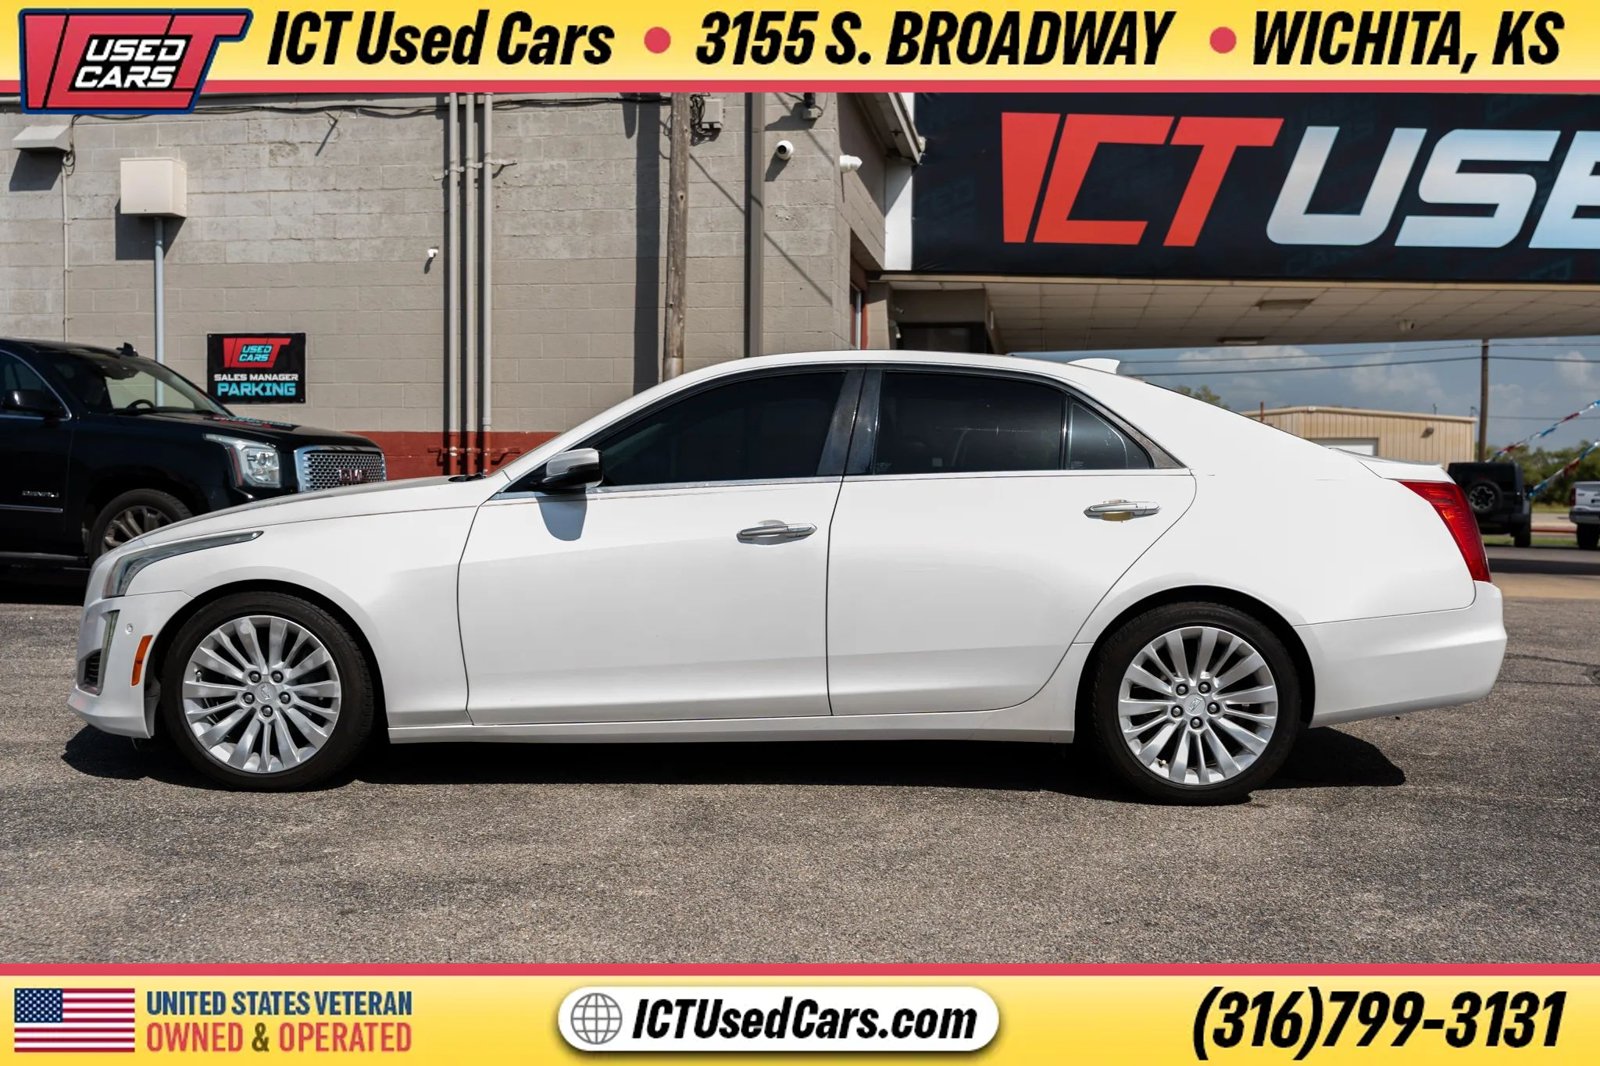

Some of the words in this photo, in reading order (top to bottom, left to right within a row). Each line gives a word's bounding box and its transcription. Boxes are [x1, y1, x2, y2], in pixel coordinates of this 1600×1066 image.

[1001, 111, 1284, 247] ICT
[242, 345, 273, 354] USED
[239, 353, 269, 362] CARS
[214, 373, 247, 381] SALES
[249, 373, 299, 381] MANAGER
[217, 382, 296, 397] PARKING
